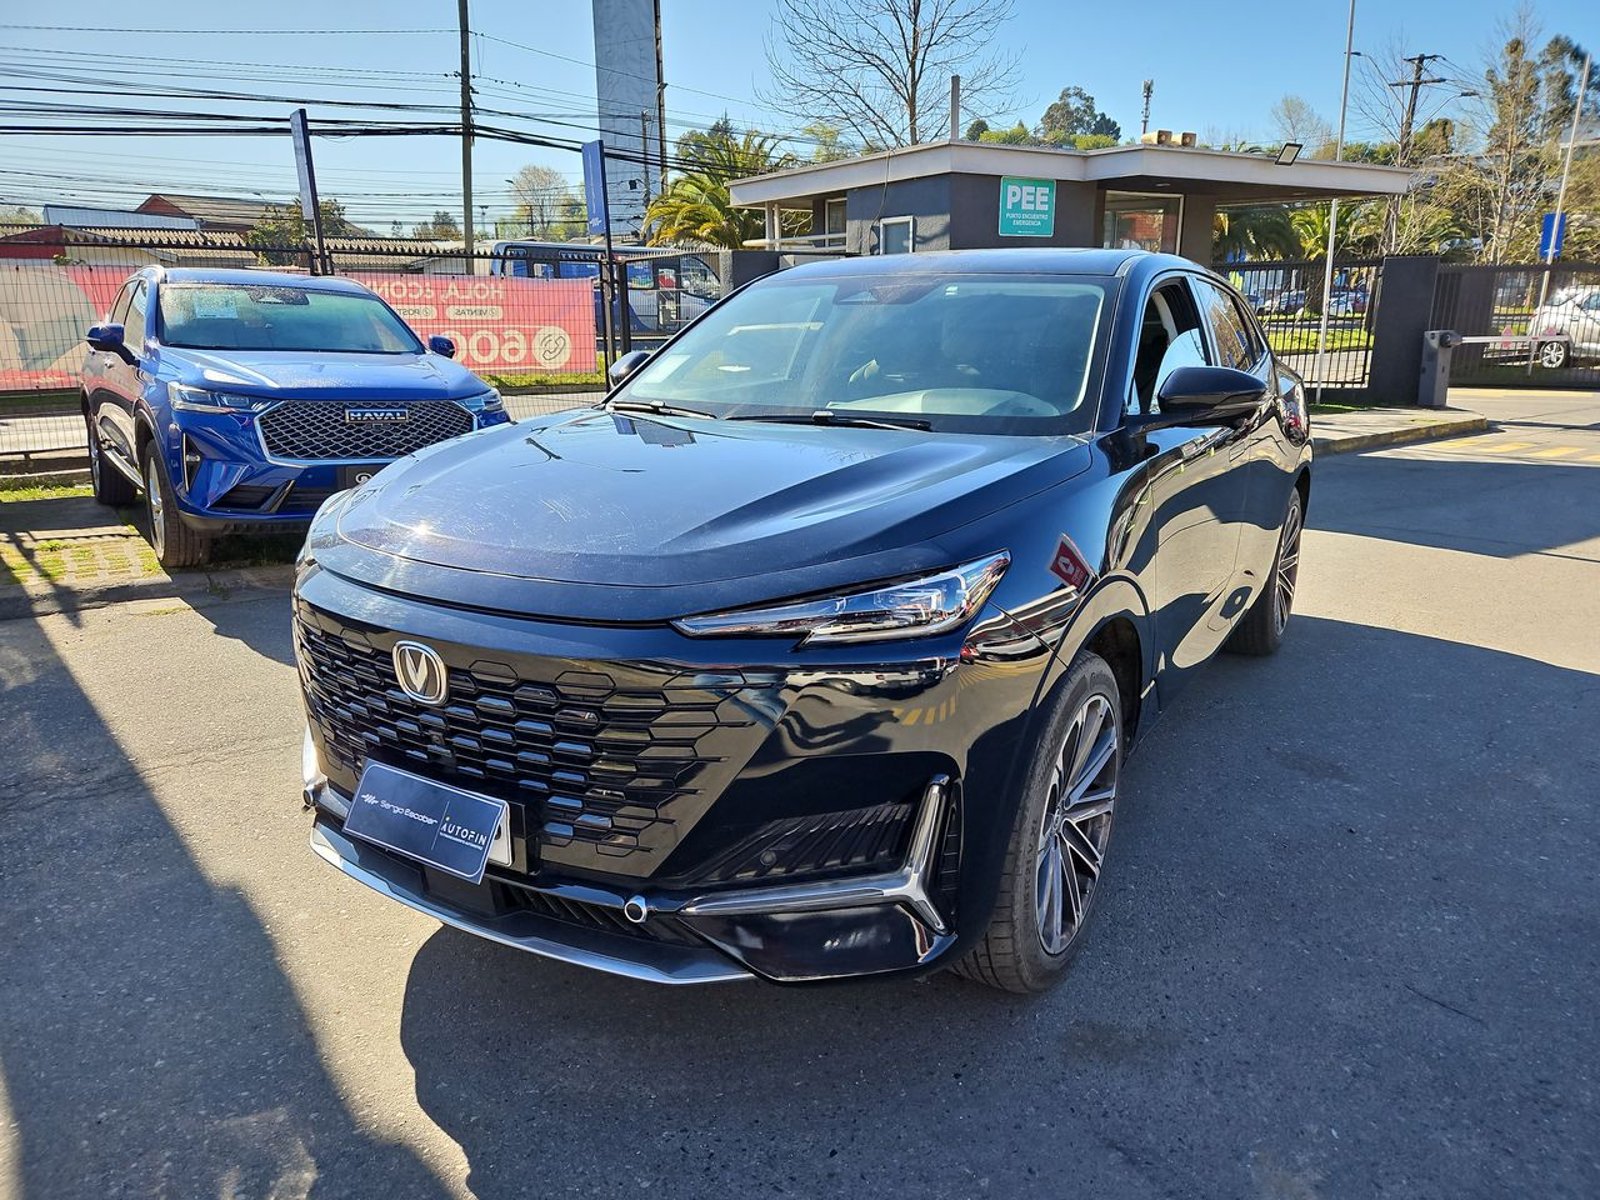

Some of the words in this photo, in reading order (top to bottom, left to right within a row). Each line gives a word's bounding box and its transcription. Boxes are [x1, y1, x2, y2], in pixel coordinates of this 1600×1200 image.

[1006, 184, 1050, 211] PEE
[350, 412, 406, 421] HAVAL
[440, 821, 487, 846] AUTOFIN
